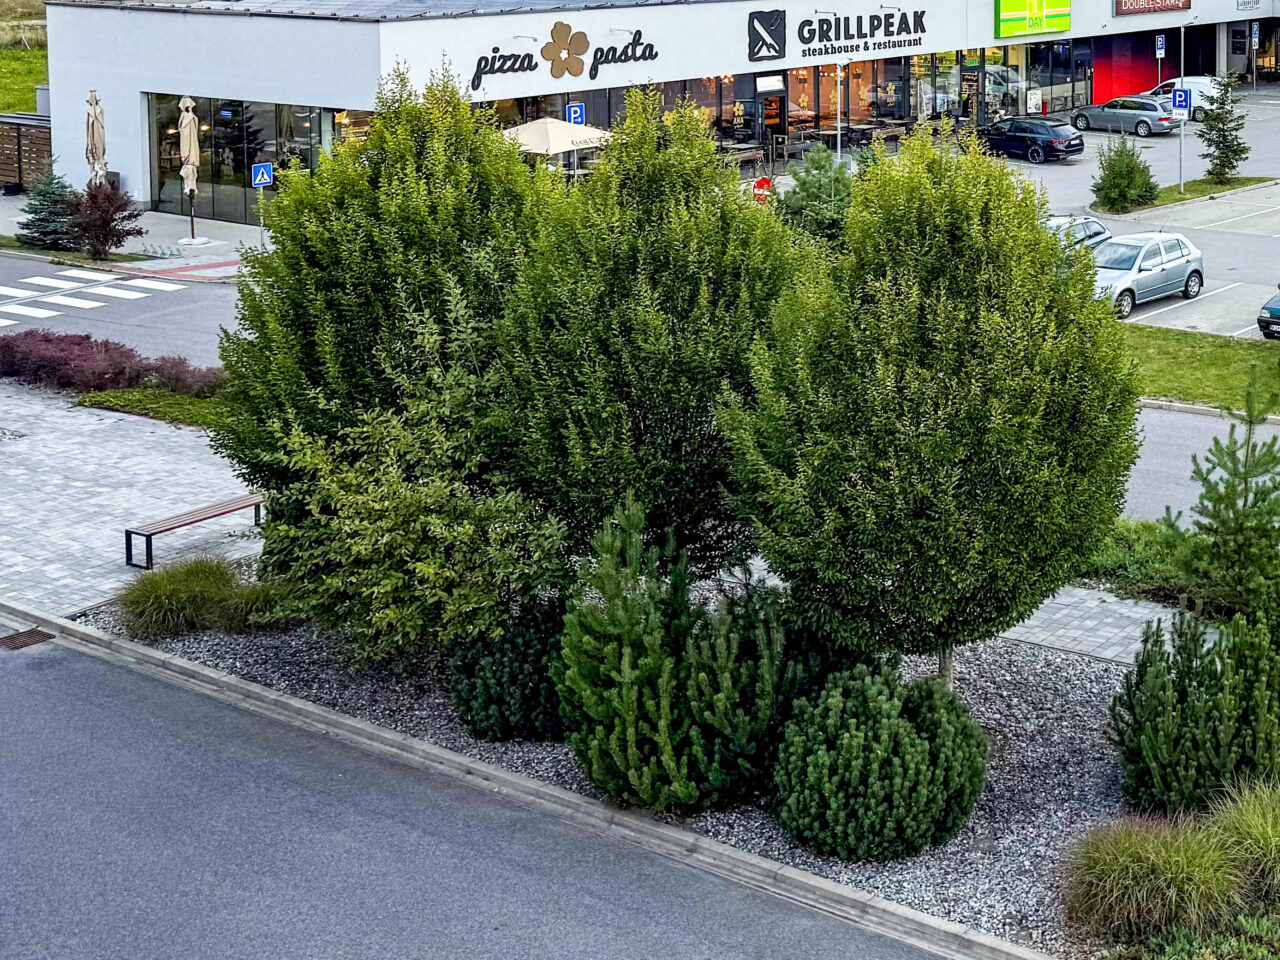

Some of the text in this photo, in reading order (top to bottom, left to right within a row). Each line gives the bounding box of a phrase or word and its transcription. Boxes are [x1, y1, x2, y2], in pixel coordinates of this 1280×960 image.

[797, 10, 927, 45] GRILLPEAK
[1028, 16, 1043, 28] DAY
[801, 37, 922, 58] steakhouse & restaurant
[471, 29, 658, 90] pizza pasta
[1176, 91, 1185, 107] P
[571, 106, 581, 124] P
